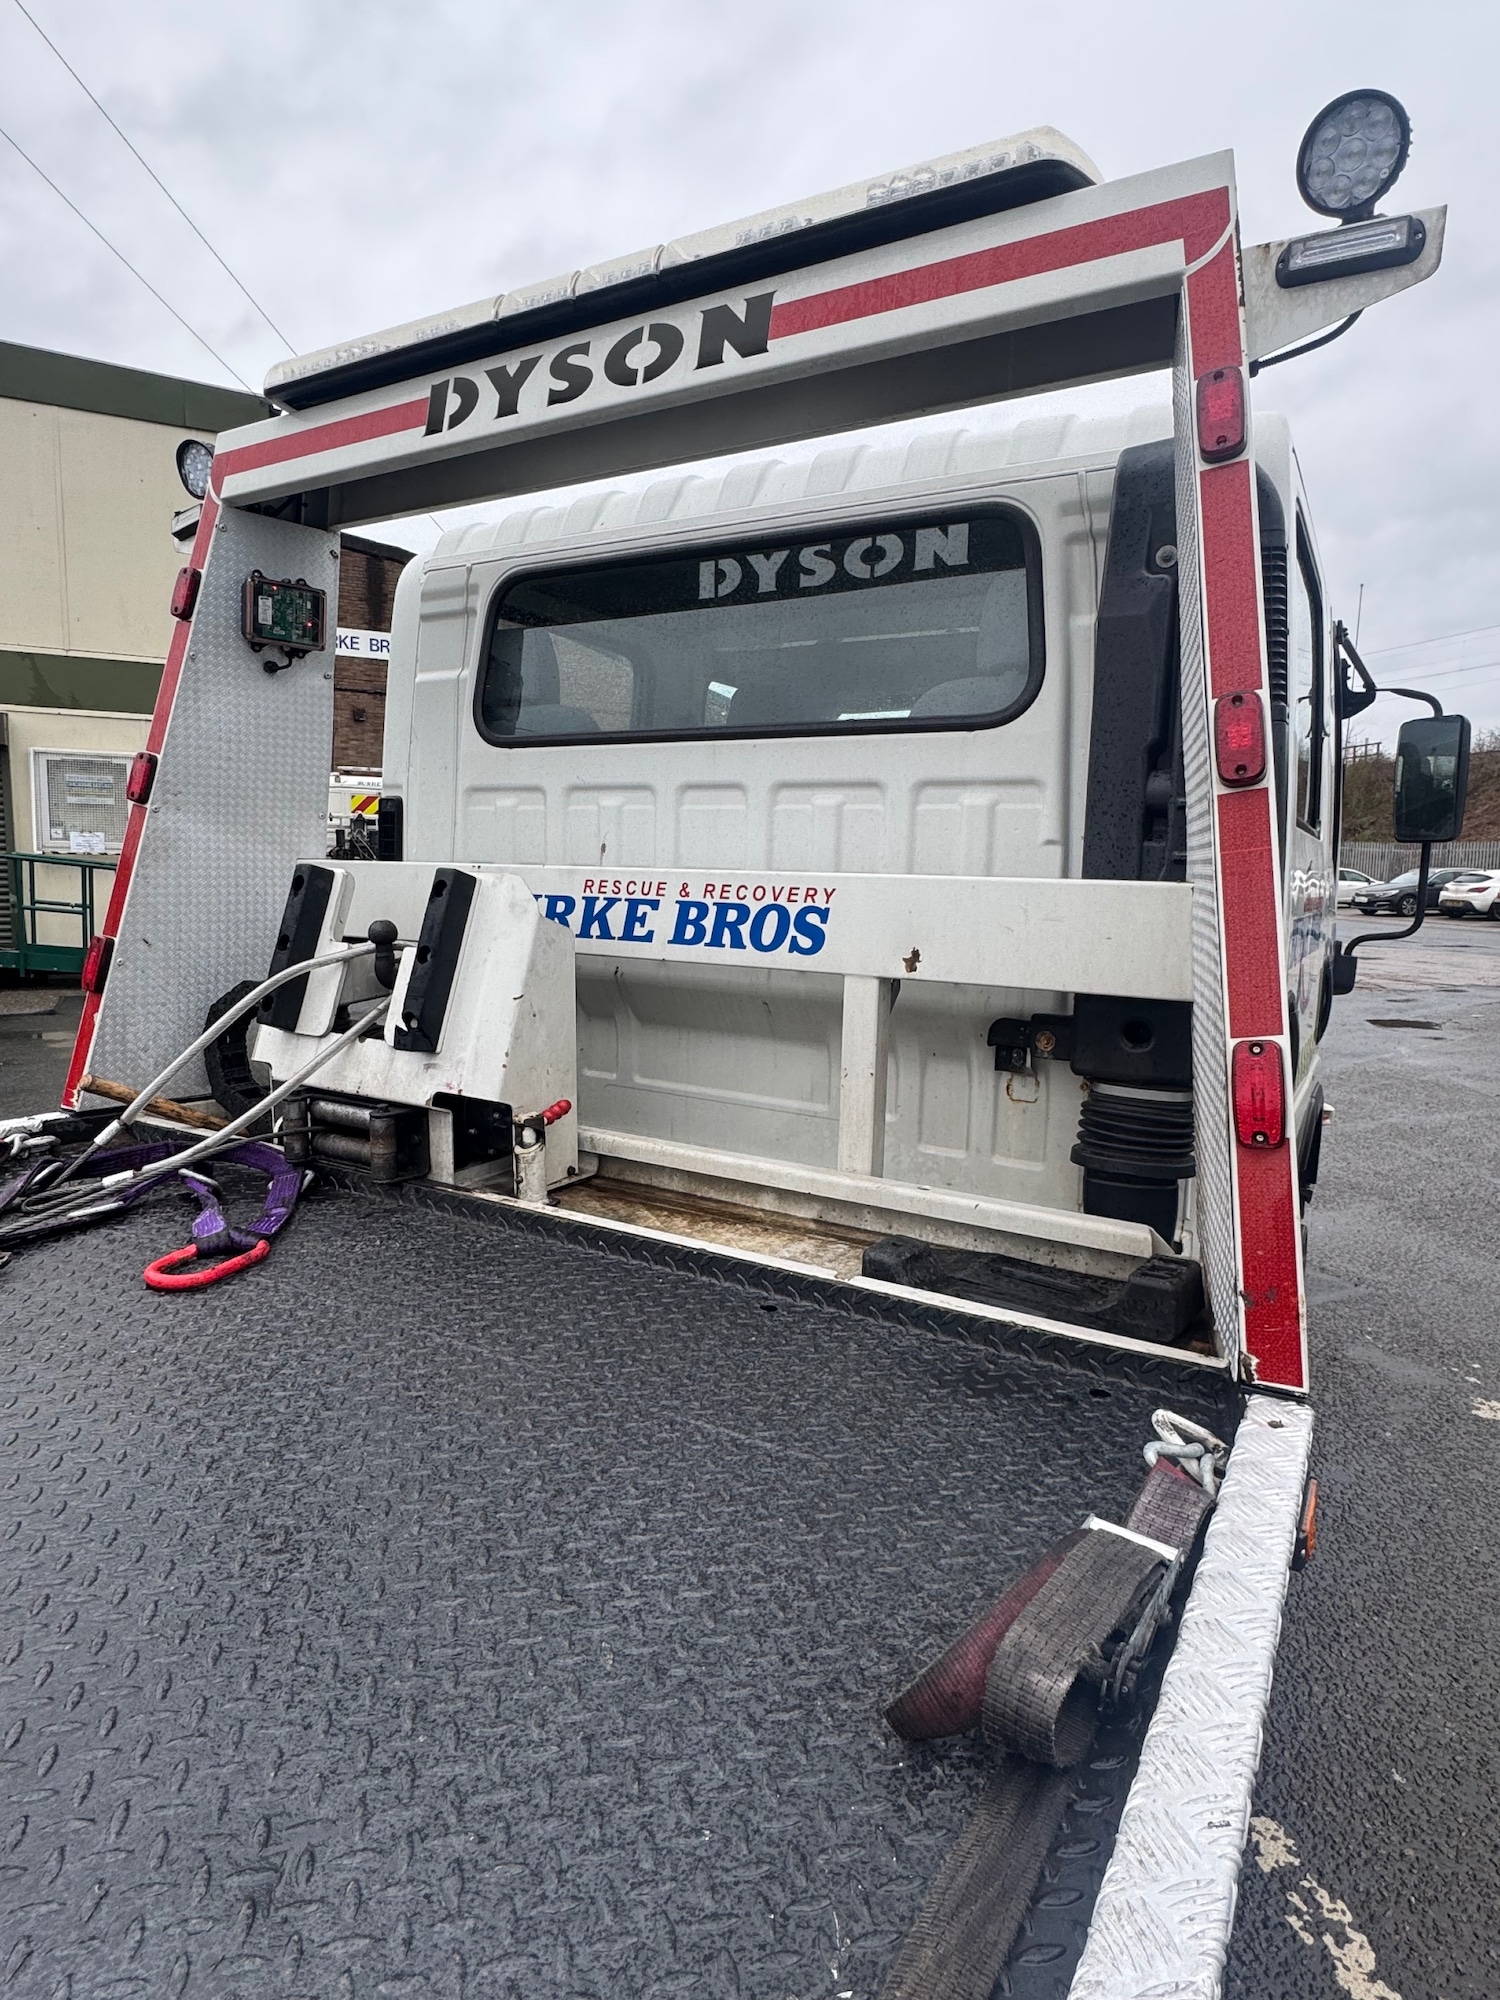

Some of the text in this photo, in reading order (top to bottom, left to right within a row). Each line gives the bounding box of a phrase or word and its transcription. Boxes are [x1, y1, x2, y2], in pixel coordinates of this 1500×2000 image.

[423, 290, 777, 437] DYSON
[698, 523, 969, 600] DYSON
[532, 894, 831, 956] RKE BROS
[583, 879, 837, 904] RESCUE & RECOVERY
